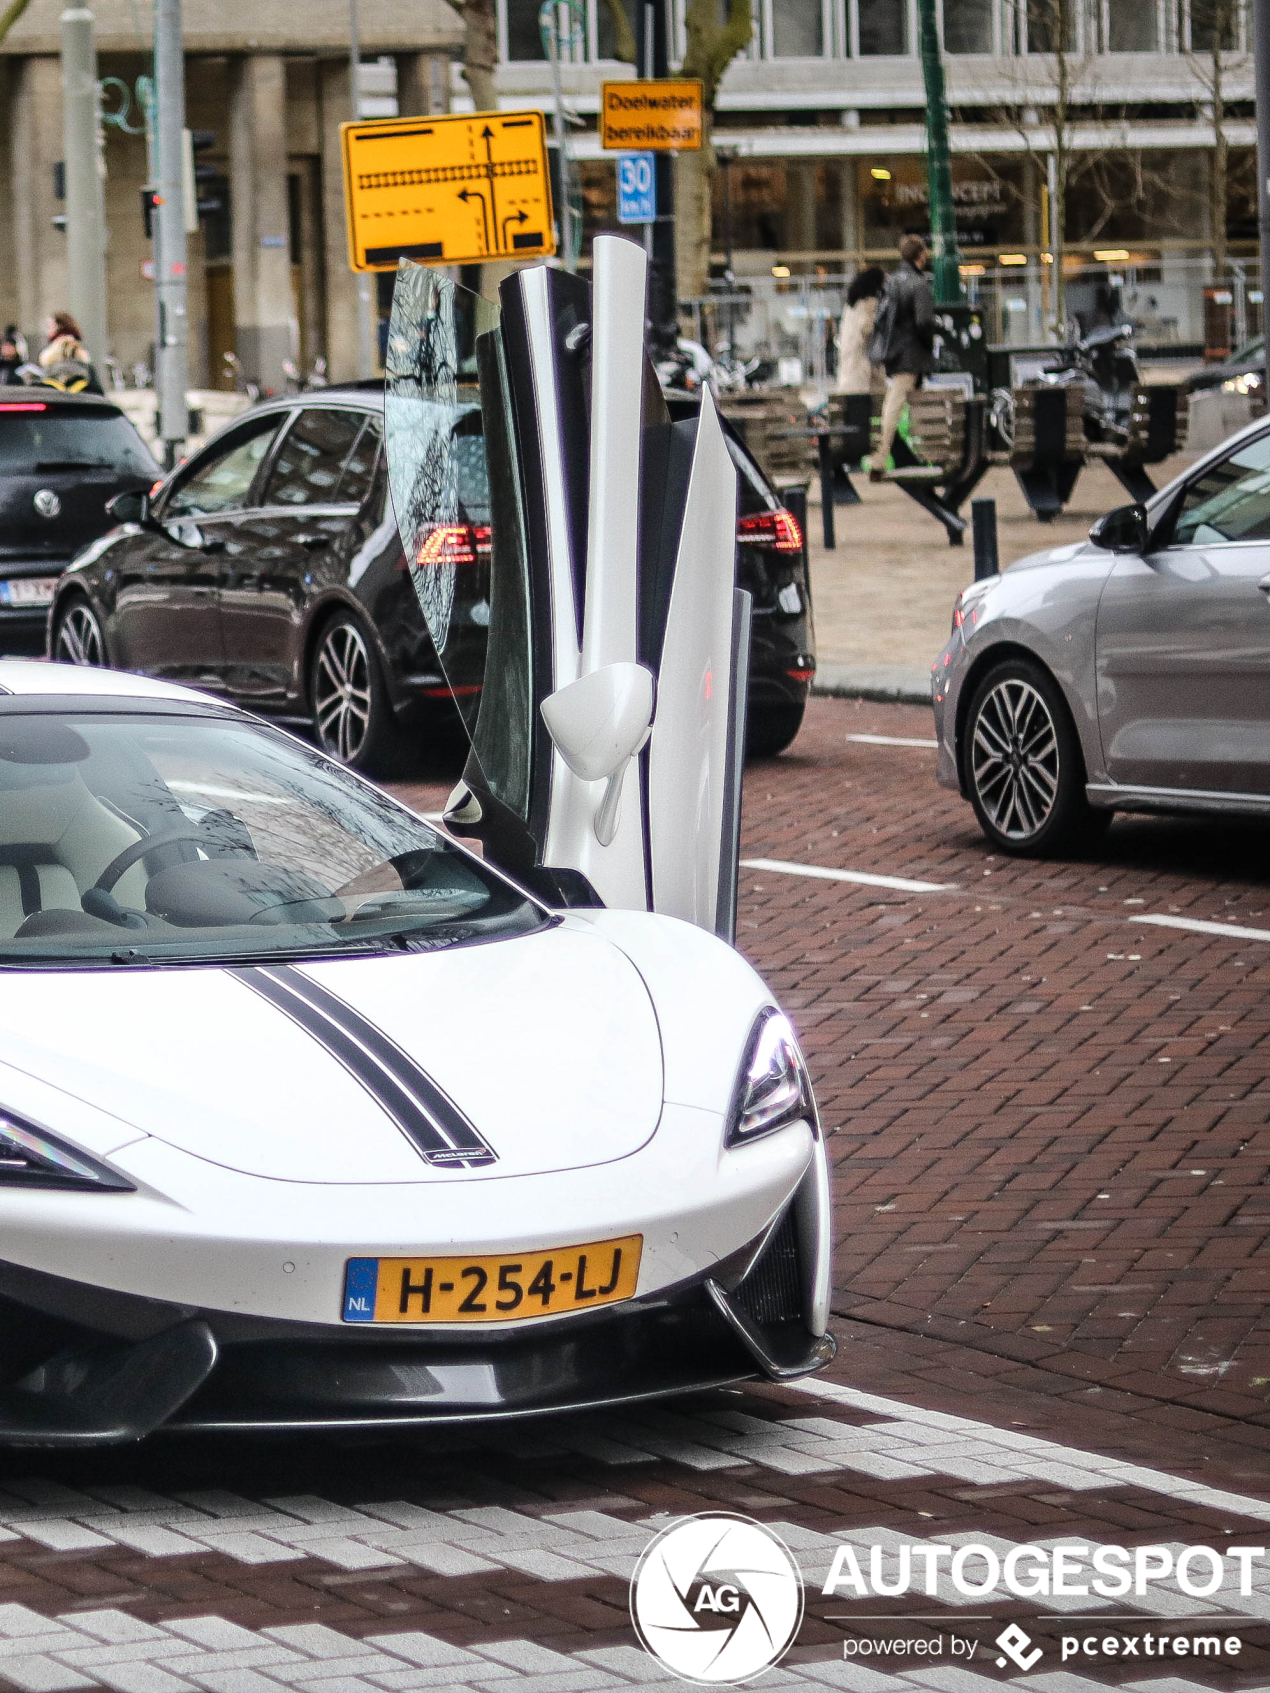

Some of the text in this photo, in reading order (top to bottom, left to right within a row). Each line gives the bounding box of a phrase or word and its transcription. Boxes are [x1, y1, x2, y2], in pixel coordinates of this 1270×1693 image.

[621, 158, 652, 194] 30
[399, 1248, 623, 1314] H-254-LJ
[348, 1297, 370, 1312] NL
